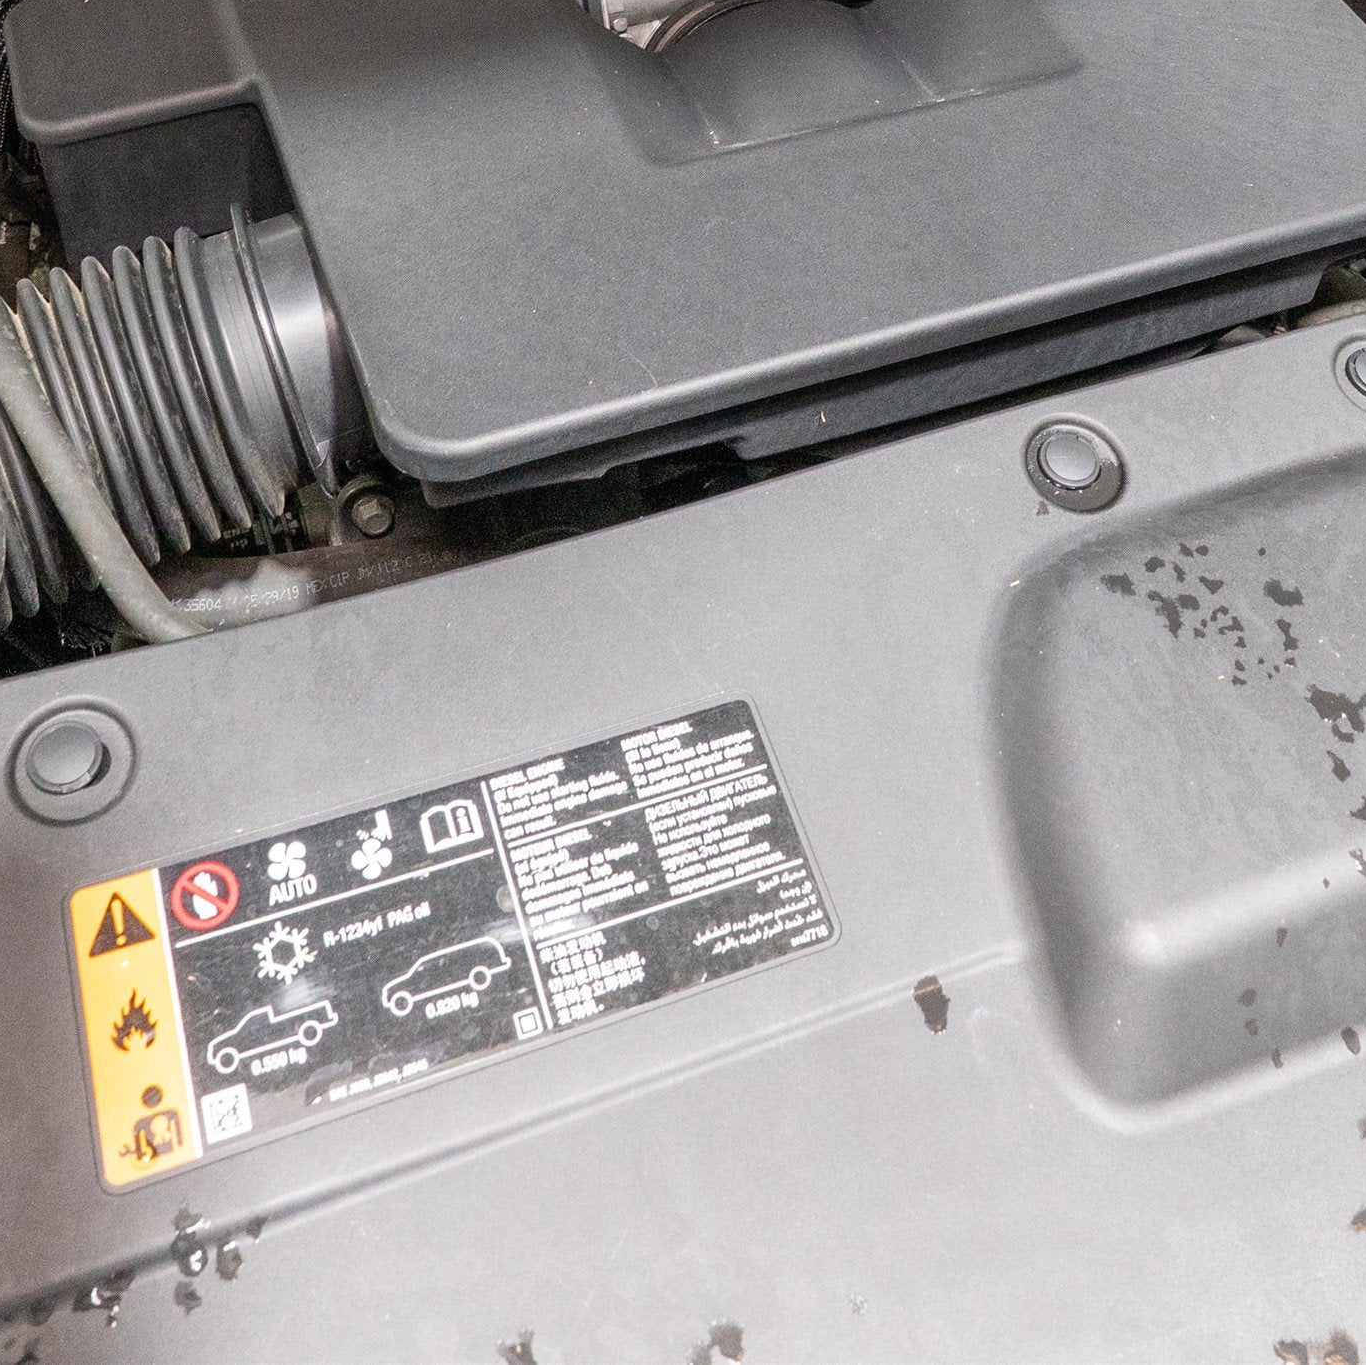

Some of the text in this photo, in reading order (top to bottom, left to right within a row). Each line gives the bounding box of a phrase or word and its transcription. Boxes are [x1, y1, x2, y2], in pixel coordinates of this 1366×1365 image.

[656, 721, 692, 740] DIESEL
[489, 770, 527, 790] DIESEL
[554, 827, 592, 849] DIESEL
[269, 874, 317, 905] AUTO
[323, 901, 430, 947] R-1234yf PAG oil
[461, 992, 479, 1007] kg
[288, 1047, 307, 1064] kg
